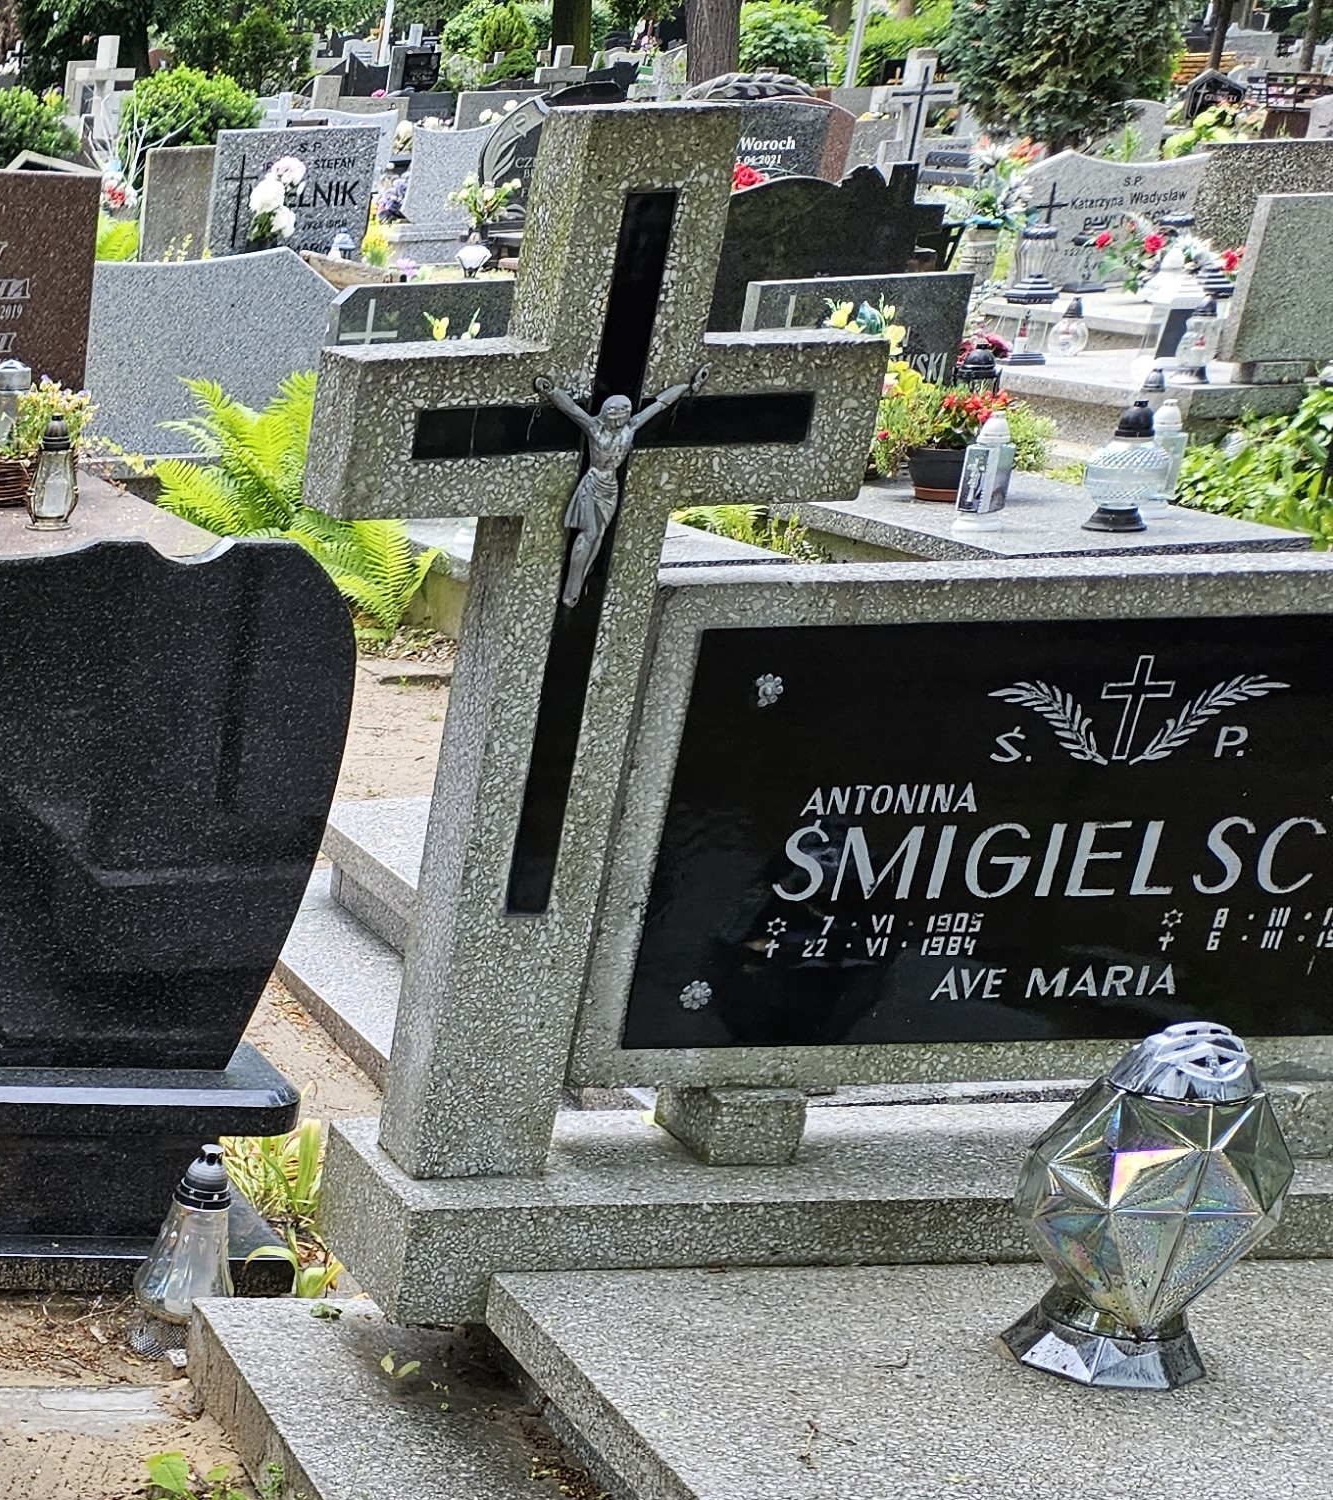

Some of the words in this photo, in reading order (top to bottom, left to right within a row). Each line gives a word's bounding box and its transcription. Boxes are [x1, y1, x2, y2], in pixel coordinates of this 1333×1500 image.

[741, 135, 796, 151] Woroch
[314, 158, 355, 169] STEFAN
[1071, 196, 1124, 211] Katarzyna
[1129, 189, 1188, 207] Władysław
[989, 725, 1032, 763] Ś.
[1213, 725, 1249, 758] P.
[800, 782, 978, 817] ANTONINA
[920, 935, 977, 956] 1984
[930, 965, 1008, 1001] AVE
[1025, 963, 1176, 999] MARIA
